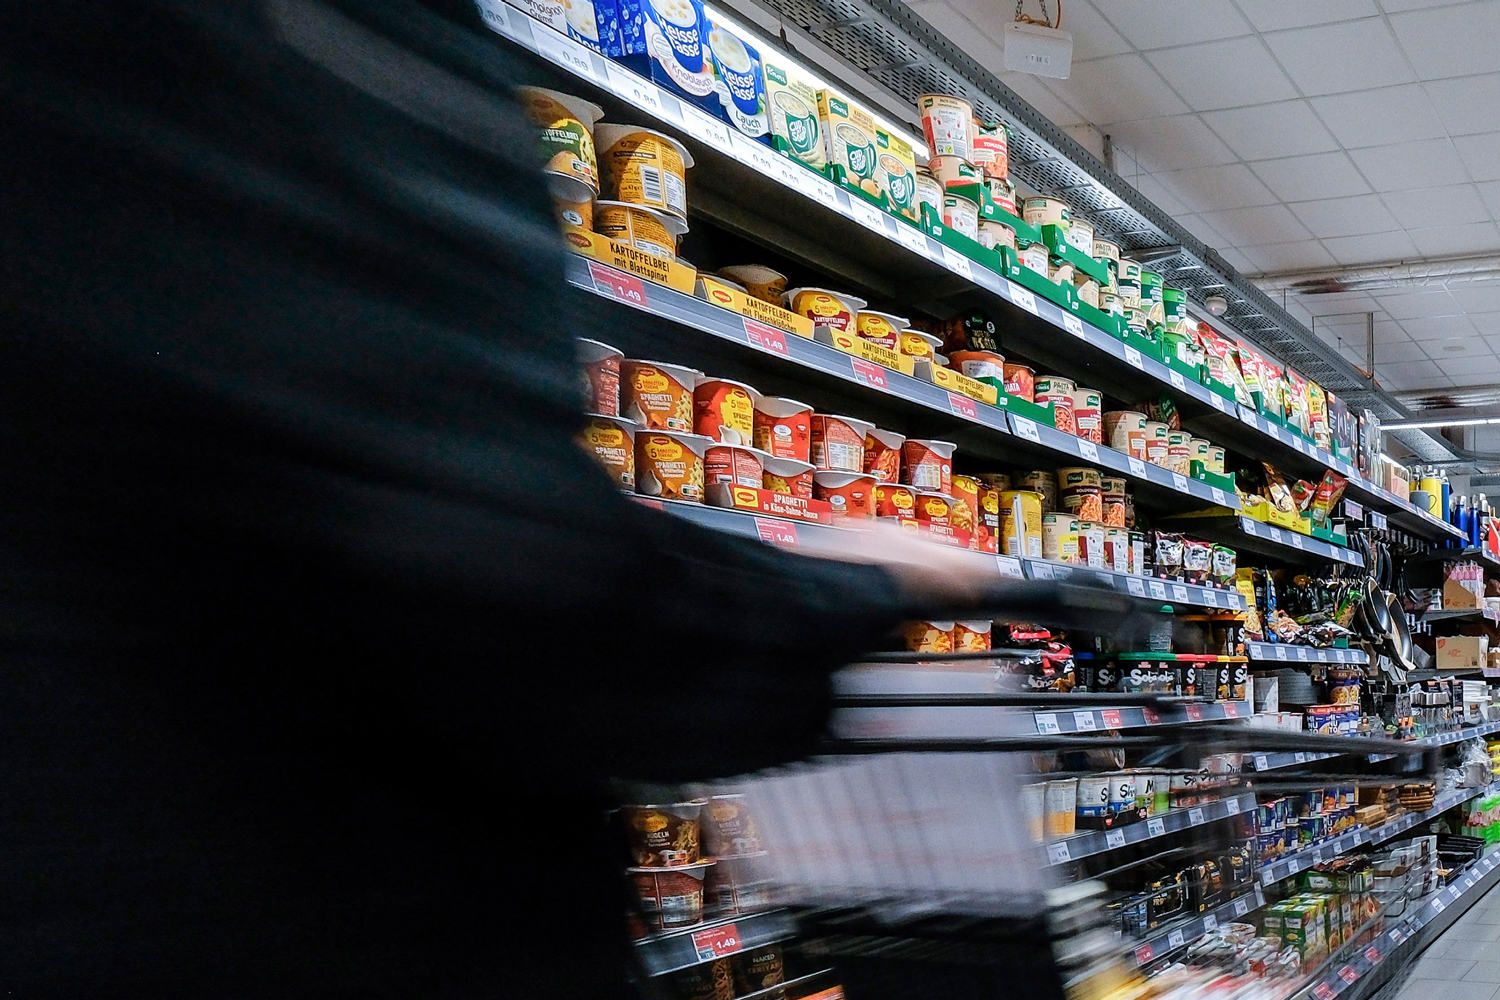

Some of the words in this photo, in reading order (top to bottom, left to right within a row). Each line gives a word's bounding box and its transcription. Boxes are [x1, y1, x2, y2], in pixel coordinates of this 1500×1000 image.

[735, 109, 762, 130] Lauch
[610, 242, 670, 273] KARTOFFELBREI
[614, 257, 628, 269] mit
[630, 260, 669, 284] Blattspinat
[617, 286, 642, 302] 1.49
[746, 296, 793, 324] KARTOFFELBREI
[764, 337, 784, 351] 1.49
[773, 494, 808, 509] SPAGHETTI
[776, 533, 795, 544] 1.49
[715, 937, 737, 950] 1.49
